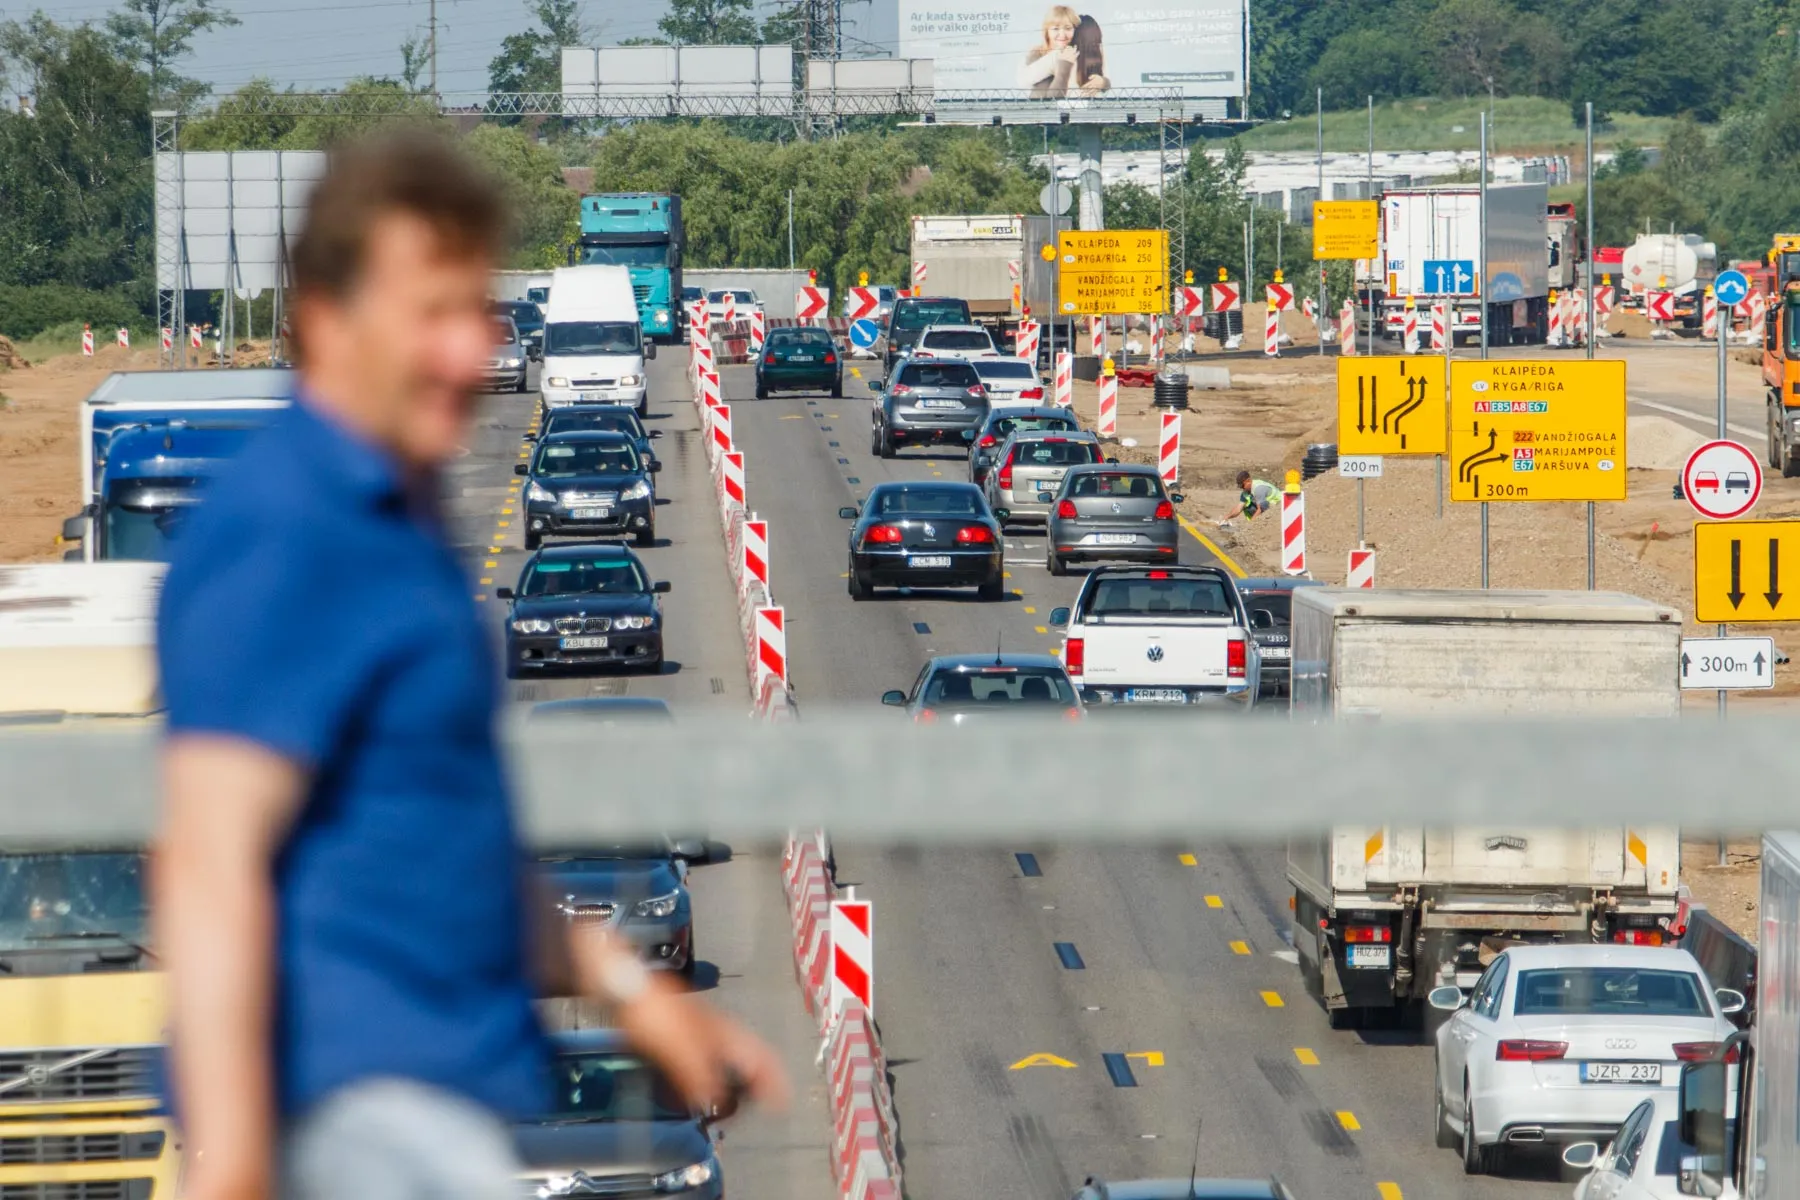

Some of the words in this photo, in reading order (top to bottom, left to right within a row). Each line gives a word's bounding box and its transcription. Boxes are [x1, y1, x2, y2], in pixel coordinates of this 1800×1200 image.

[910, 12, 923, 21] Ar
[926, 11, 954, 21] kada
[910, 23, 935, 33] apie
[938, 22, 968, 32] vaiko
[1137, 239, 1152, 248] 209
[1137, 254, 1152, 263] 250
[1144, 275, 1152, 284] 21
[1143, 288, 1152, 297] 63
[1493, 363, 1555, 376] KLAIPĖDA
[1493, 382, 1564, 391] RYGA/RIGA
[1476, 402, 1489, 412] A1
[1491, 402, 1510, 412] E85
[1513, 402, 1527, 412] A8
[1528, 402, 1547, 412] E67
[1514, 432, 1534, 442] 222
[1535, 431, 1617, 441] VANDŽIOGALA
[1515, 449, 1532, 459] A5
[1534, 445, 1617, 456] MARIJAMPOLĖ
[1514, 460, 1533, 470] E67
[1535, 460, 1590, 471] VARŠUVA
[566, 639, 585, 648] KBU
[590, 638, 606, 647] 637
[1134, 689, 1156, 699] KRM
[1356, 947, 1372, 957] HUZ
[1373, 947, 1387, 957] 379
[1590, 1064, 1621, 1078] JZR
[1631, 1065, 1658, 1079] 237
